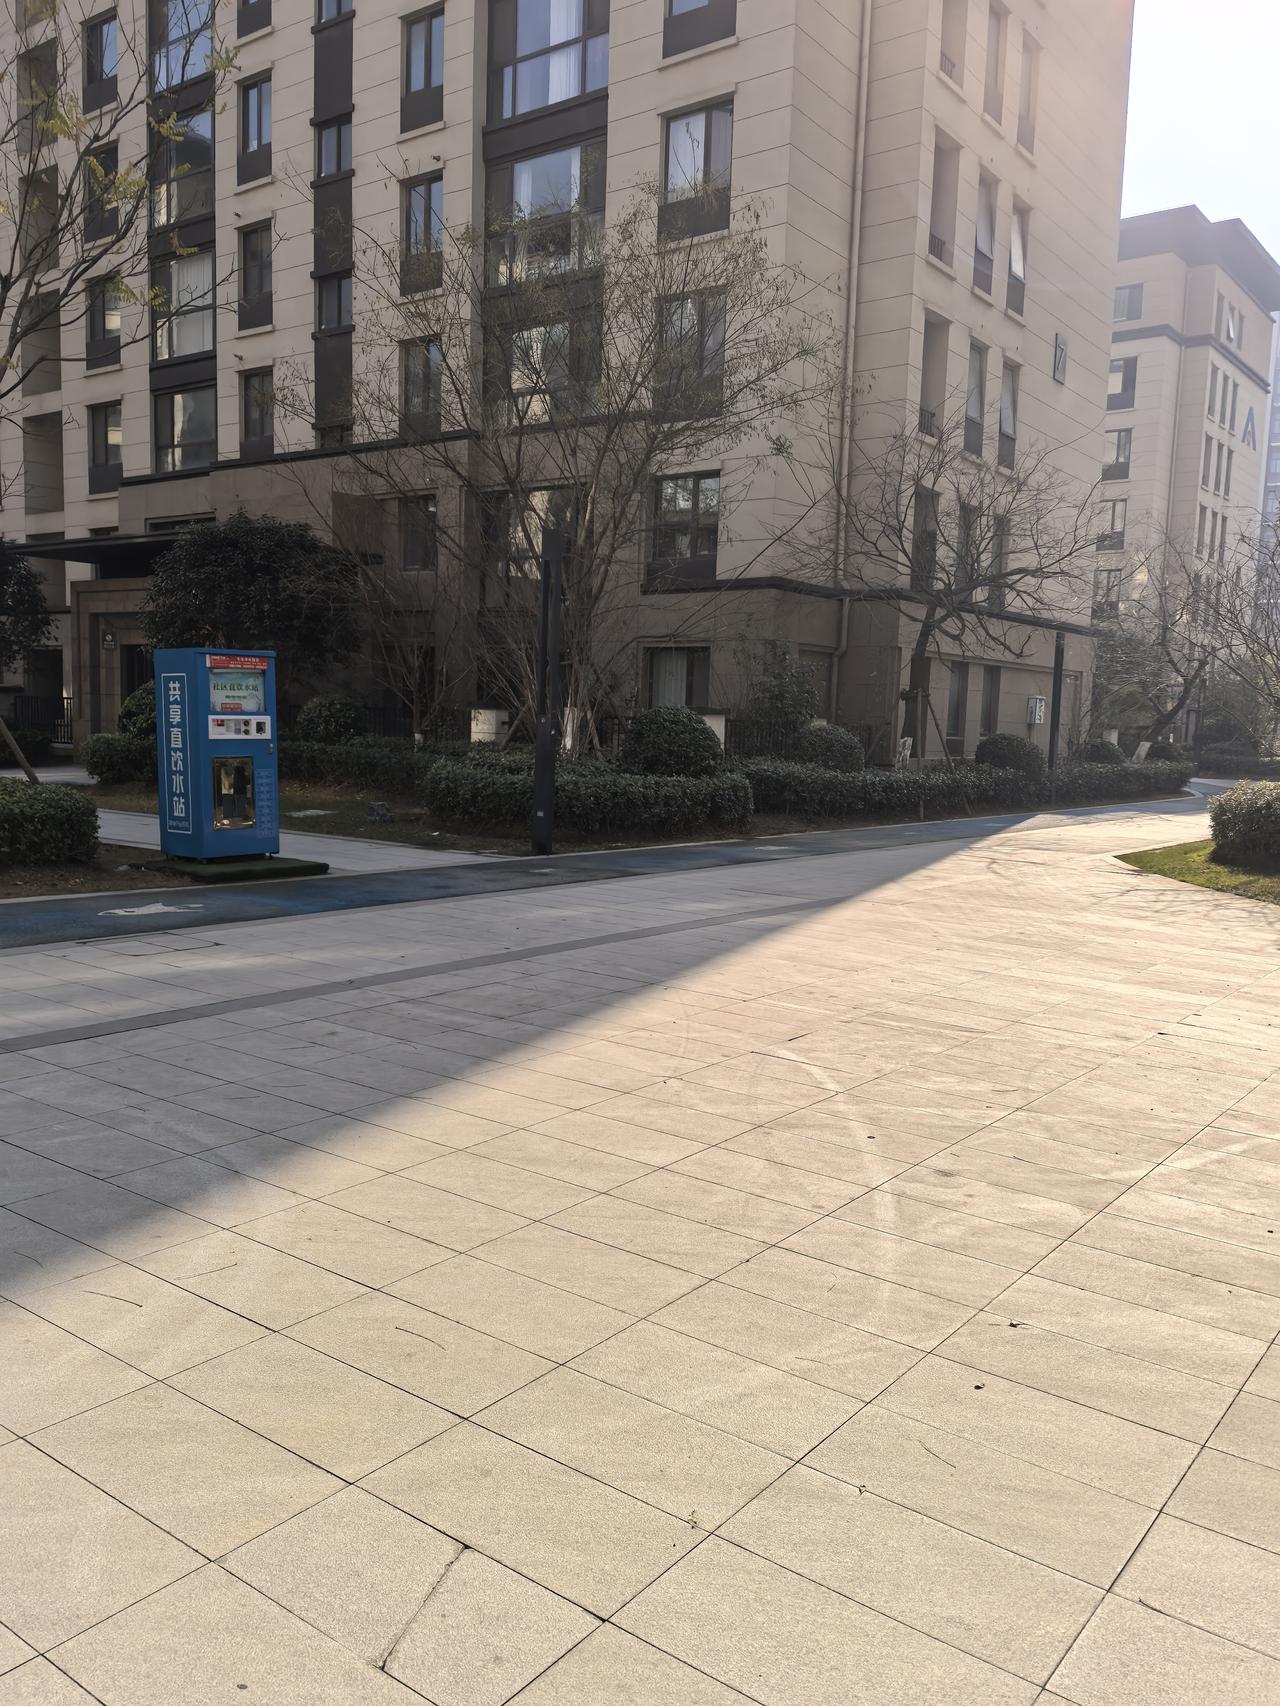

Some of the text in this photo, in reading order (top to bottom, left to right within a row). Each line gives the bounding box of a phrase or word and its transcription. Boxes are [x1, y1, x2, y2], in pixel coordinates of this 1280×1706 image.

[213, 681, 259, 692] 社区直饮水站
[168, 680, 186, 817] 共享直饮水站
